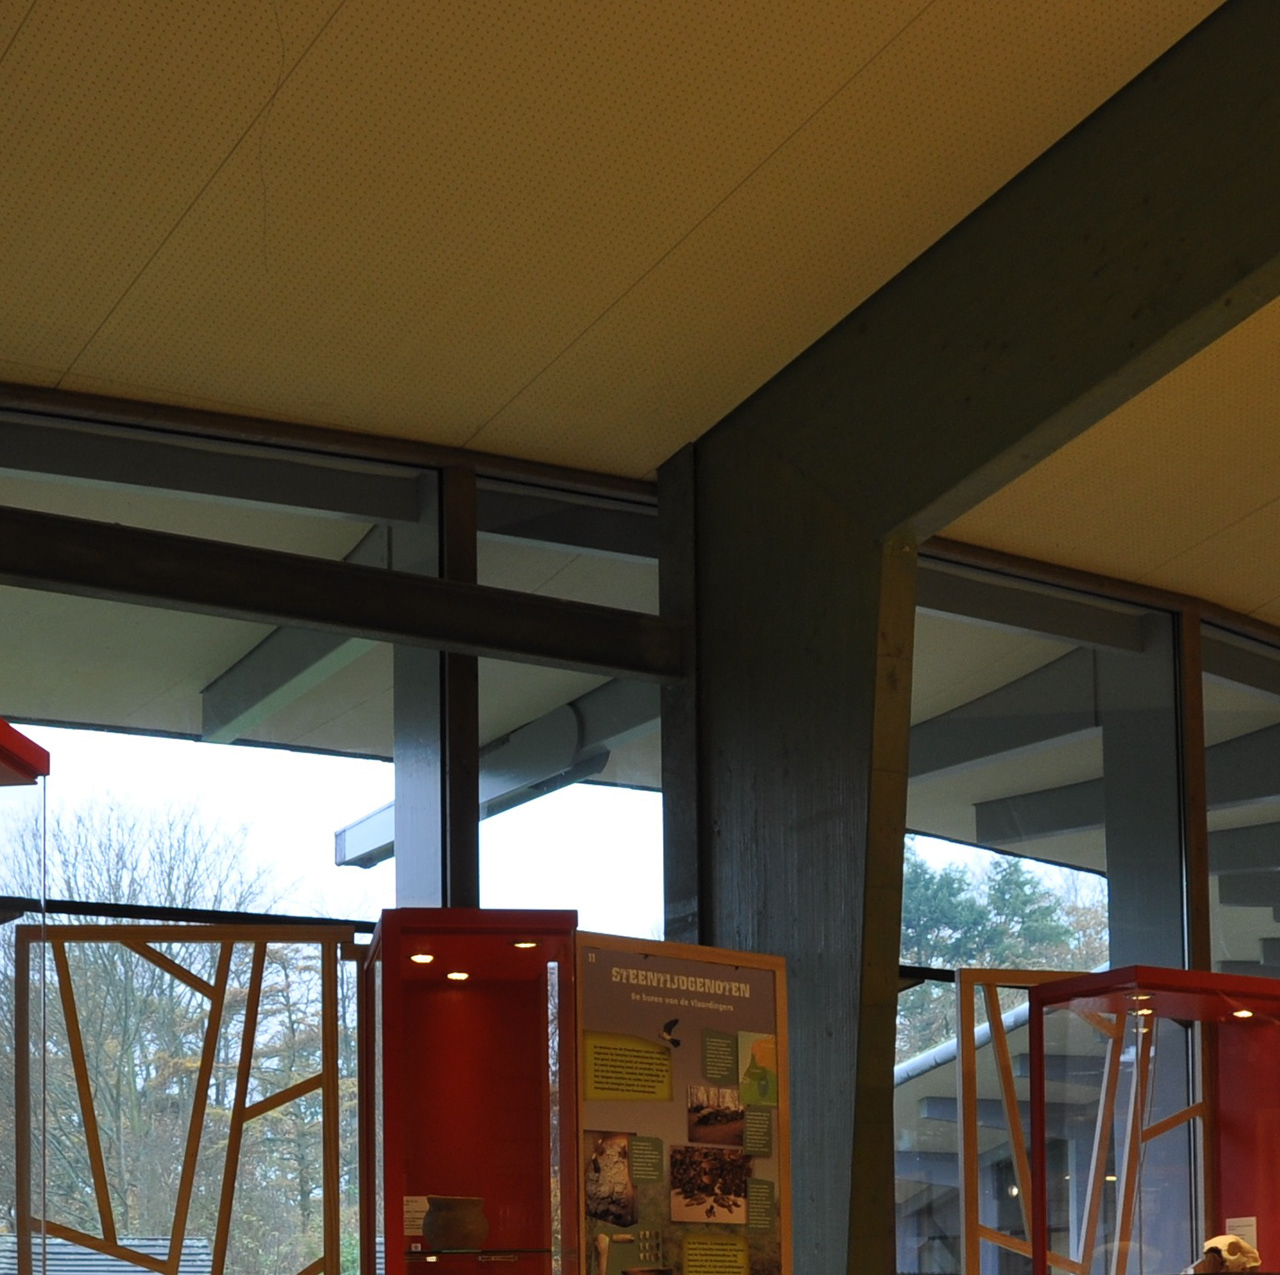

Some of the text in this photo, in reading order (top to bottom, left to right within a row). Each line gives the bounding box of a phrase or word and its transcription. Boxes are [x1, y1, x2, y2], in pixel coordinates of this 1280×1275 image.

[588, 953, 596, 963] 11
[611, 967, 750, 998] STEENTIJDGENOTEN
[642, 993, 663, 1004] buren
[665, 997, 679, 1005] van
[680, 996, 689, 1006] de
[690, 998, 733, 1012] Vlaardingers
